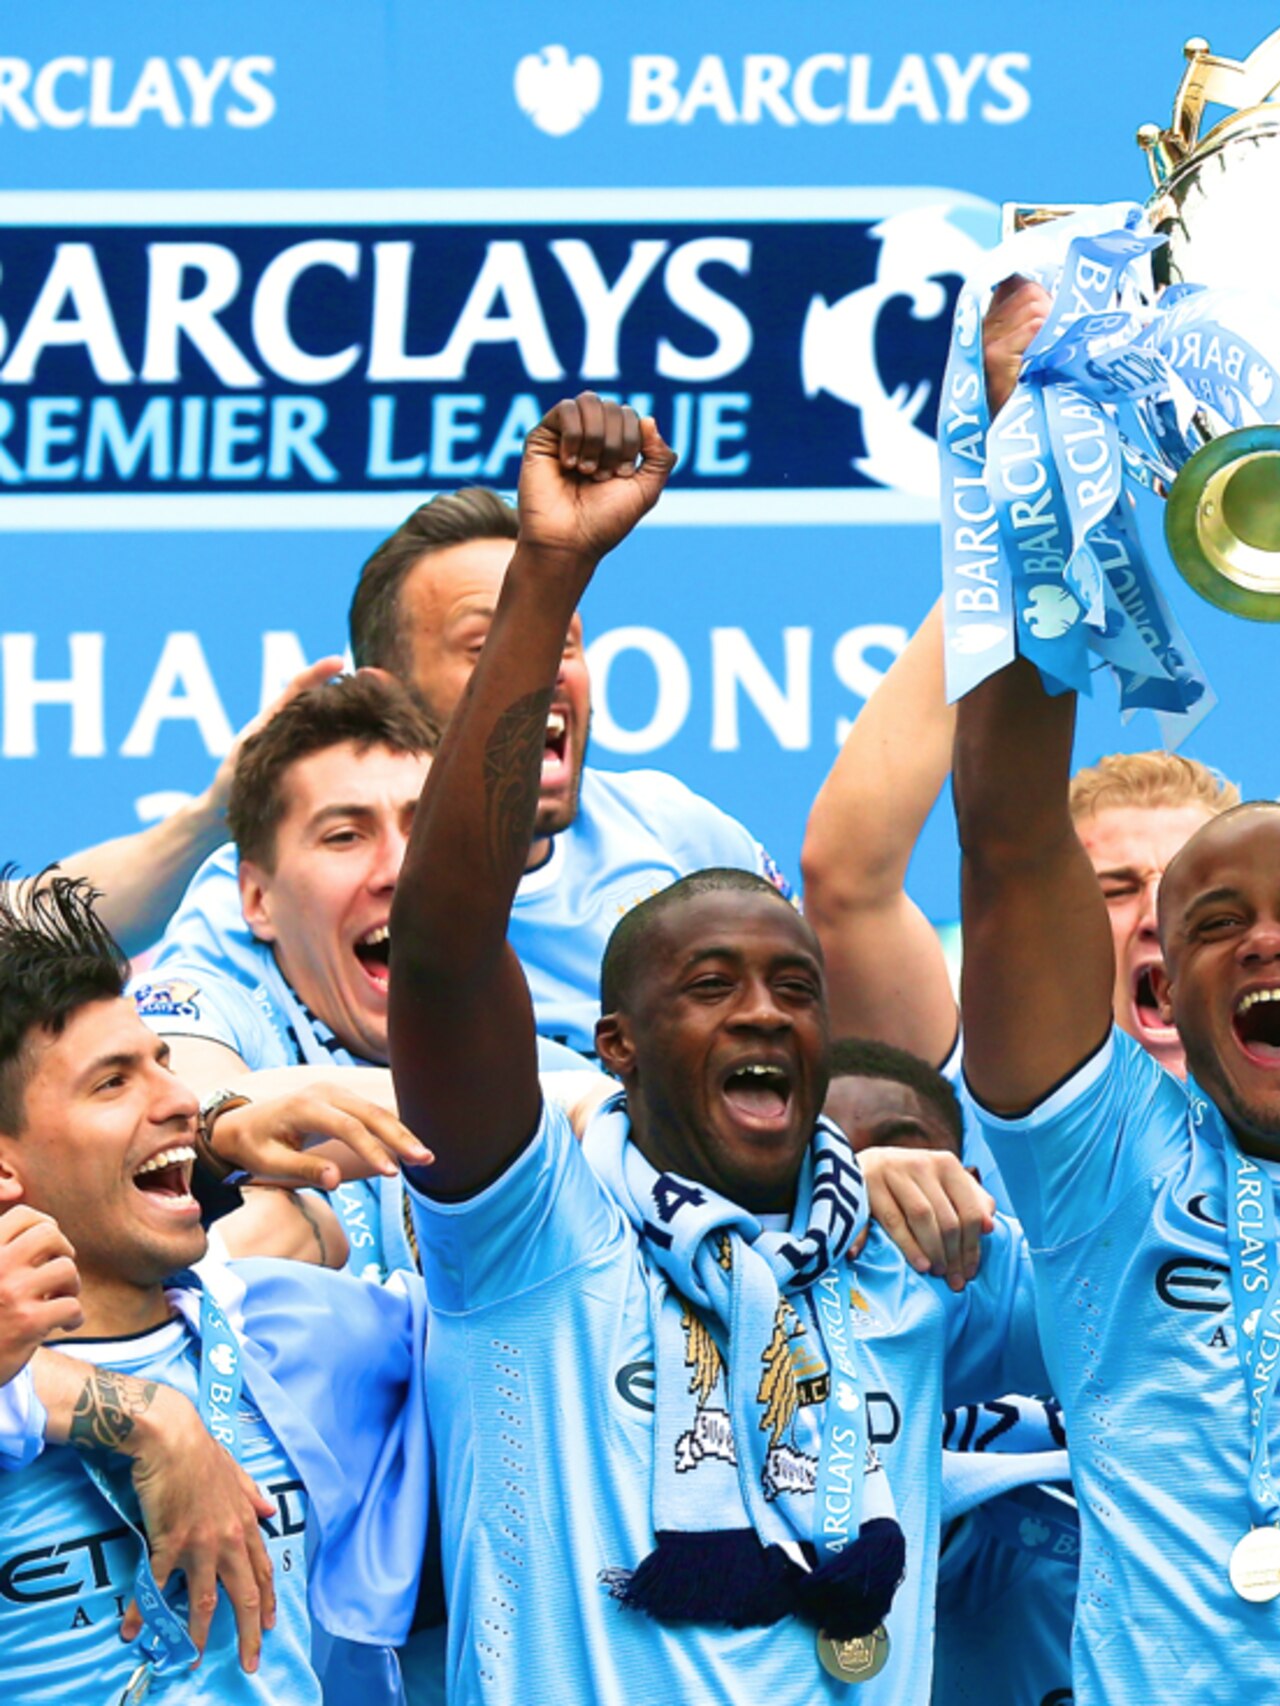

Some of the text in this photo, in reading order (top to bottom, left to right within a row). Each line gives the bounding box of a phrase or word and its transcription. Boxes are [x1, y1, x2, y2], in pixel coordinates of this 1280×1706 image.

[627, 52, 1032, 126] BARCLAYS
[0, 239, 753, 389] ARCLAYS
[366, 393, 752, 480] LEAUE
[949, 371, 1000, 614] BARCLAYS
[818, 1270, 857, 1379] BARCLA
